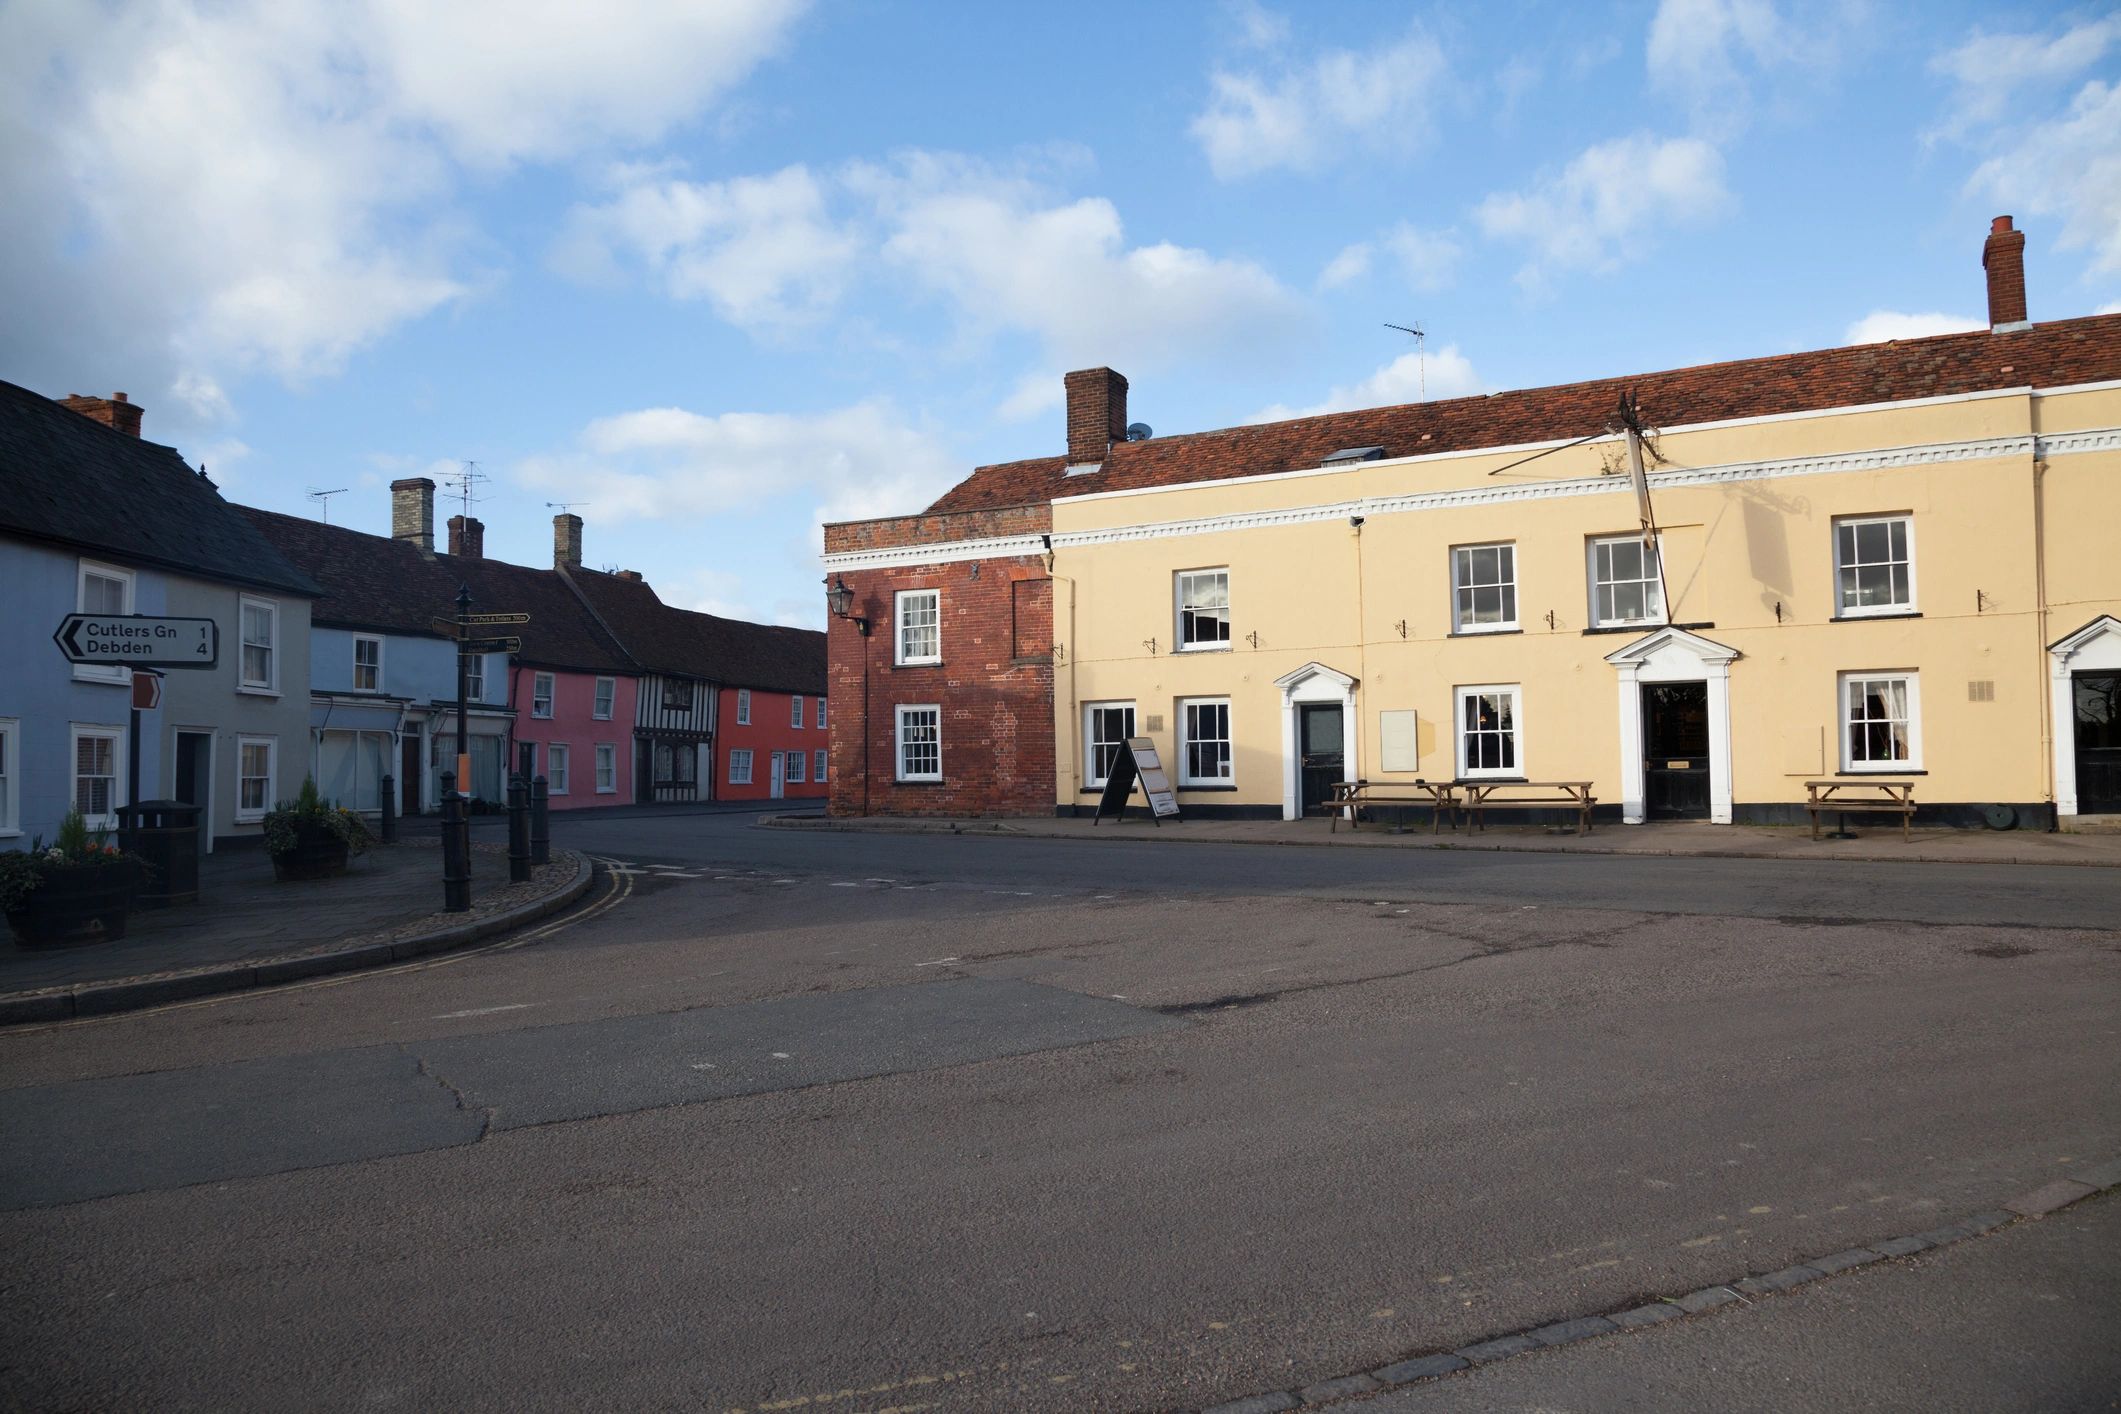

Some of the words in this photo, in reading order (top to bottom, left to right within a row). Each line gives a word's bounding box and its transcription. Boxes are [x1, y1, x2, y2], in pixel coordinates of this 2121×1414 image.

[87, 623, 150, 637] Cutlers
[154, 625, 177, 638] Gn
[200, 627, 206, 639] 1
[87, 640, 152, 654] Debden
[196, 643, 208, 655] 4
